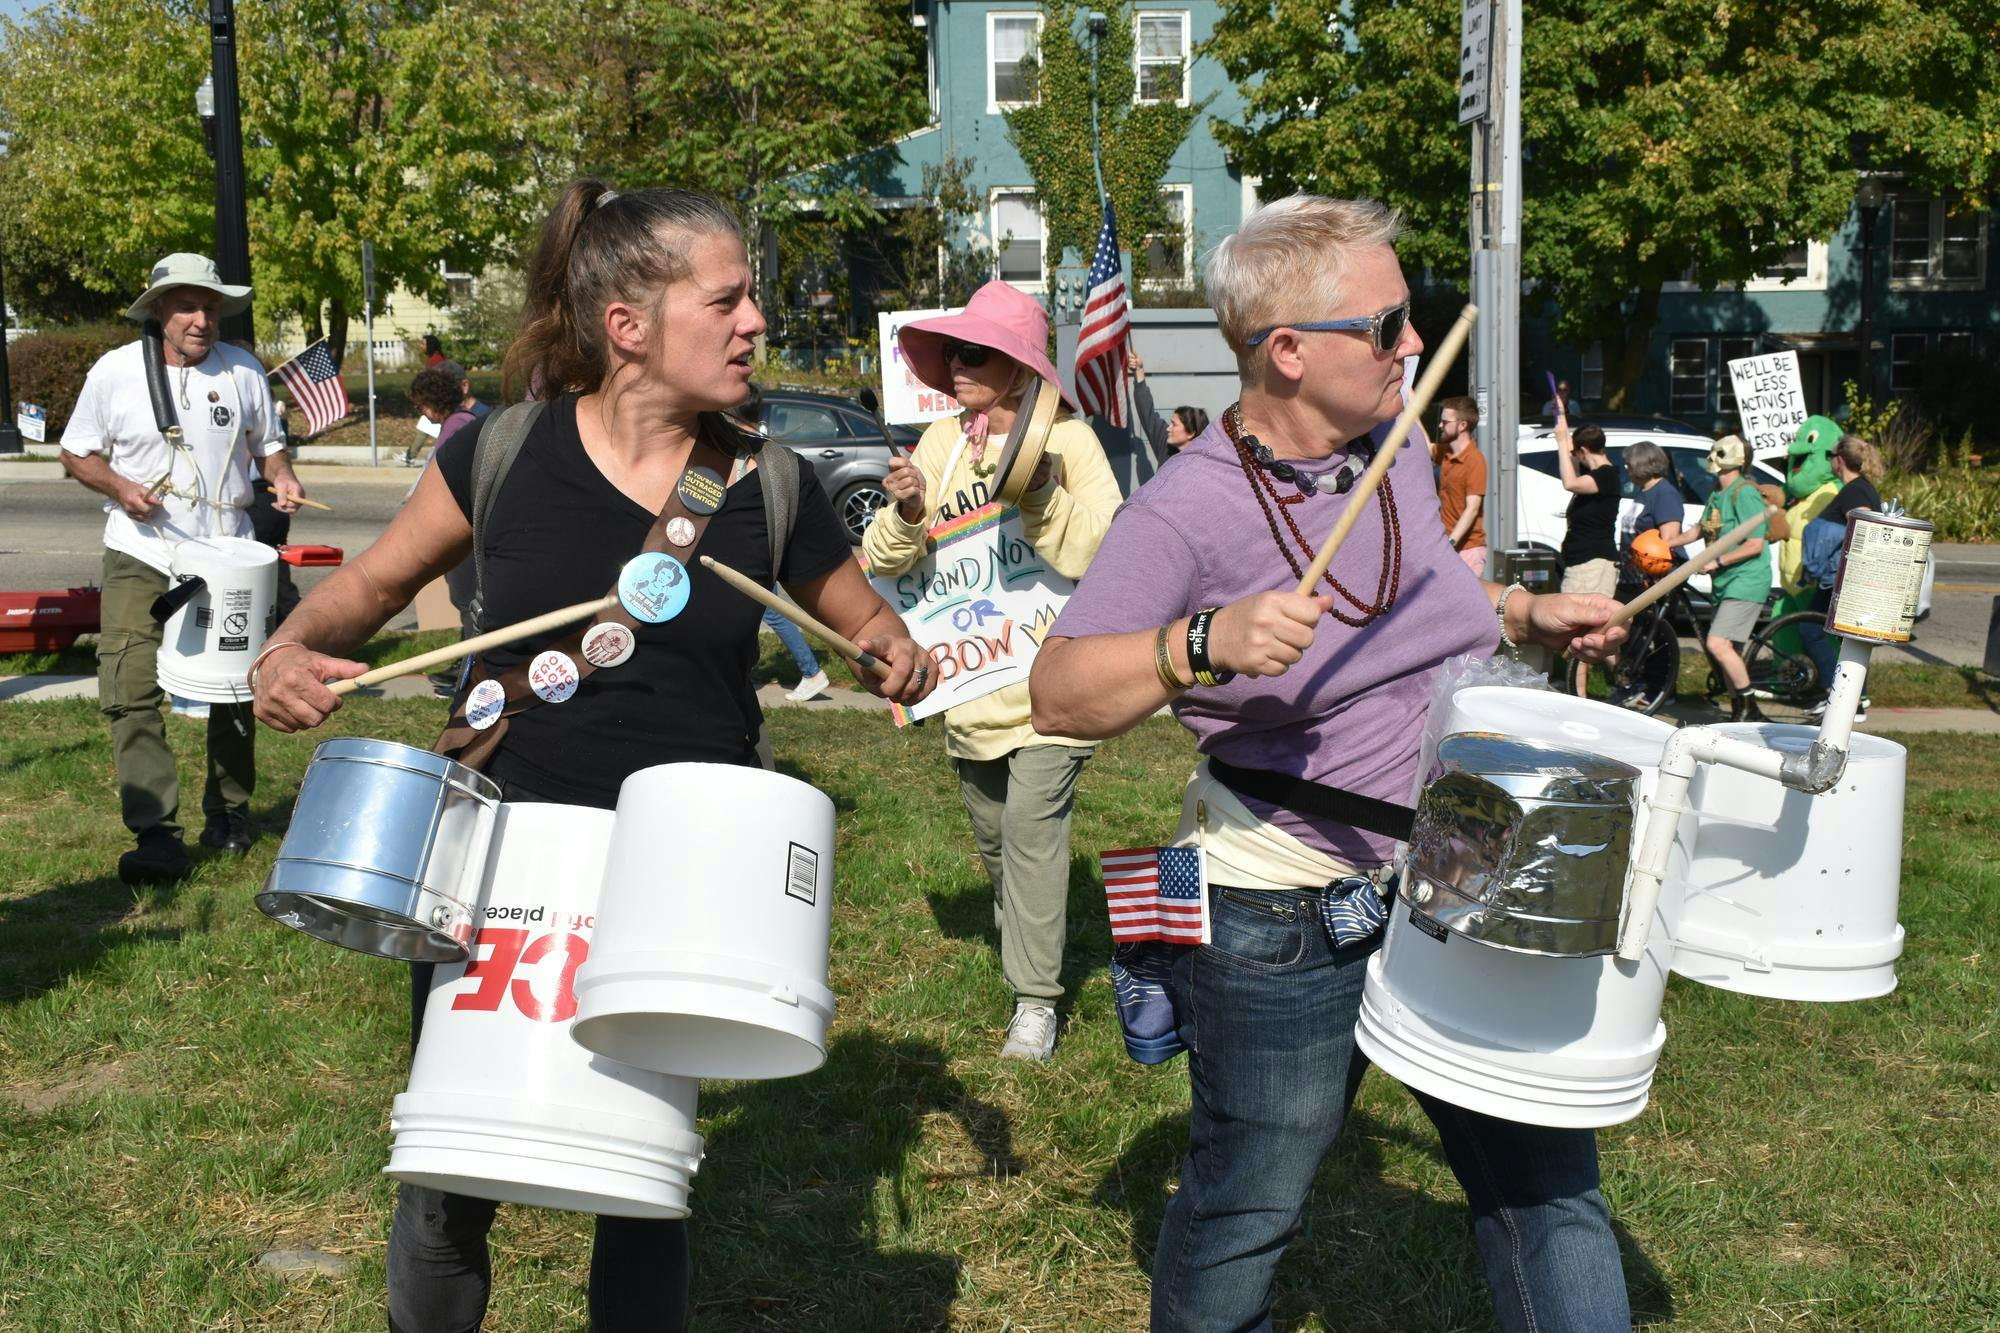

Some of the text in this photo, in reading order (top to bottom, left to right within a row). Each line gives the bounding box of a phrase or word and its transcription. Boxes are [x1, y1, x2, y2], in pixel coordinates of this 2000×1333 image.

[1731, 357, 1792, 381] WE'LL BE
[1755, 375, 1787, 392] LESS
[1741, 391, 1797, 412] ACTIVIST
[1746, 411, 1803, 430] IF YOU BE
[1749, 433, 1776, 451] LESS
[680, 485, 718, 509] ATTENTION
[685, 475, 722, 498] OUTRAGED
[712, 481, 724, 492] NOT
[952, 599, 1005, 632] OR
[927, 619, 1014, 683] BOW
[540, 663, 566, 692] GOP
[482, 906, 544, 925] place.
[451, 928, 589, 1023] CE
